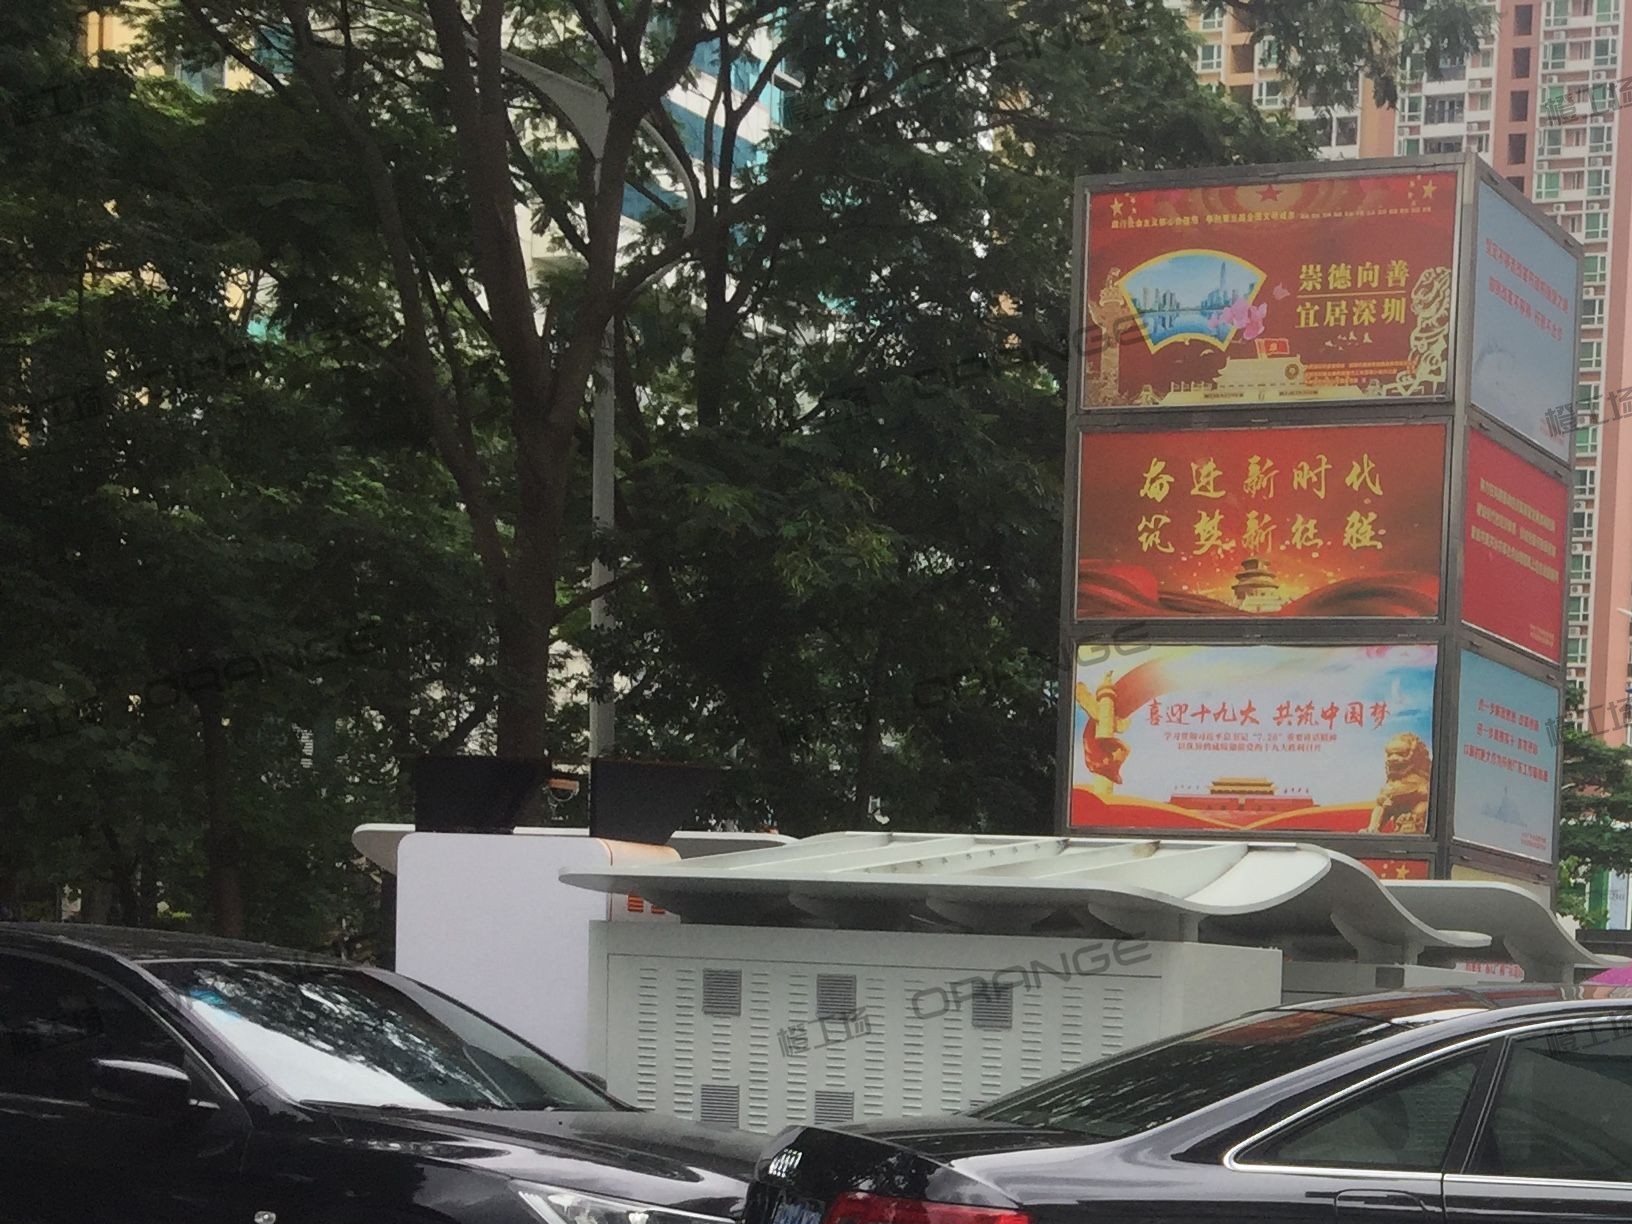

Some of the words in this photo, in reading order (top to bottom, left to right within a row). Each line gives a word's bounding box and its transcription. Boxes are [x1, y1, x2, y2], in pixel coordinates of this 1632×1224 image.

[1298, 259, 1410, 291] 崇德向善
[1295, 297, 1407, 329] 宜居深圳
[1139, 453, 1384, 503] 奋进新时代
[1137, 509, 1384, 556] 筑梦新征程
[1146, 699, 1260, 727] 喜迎十九大
[1272, 699, 1391, 731] 共筑中国梦
